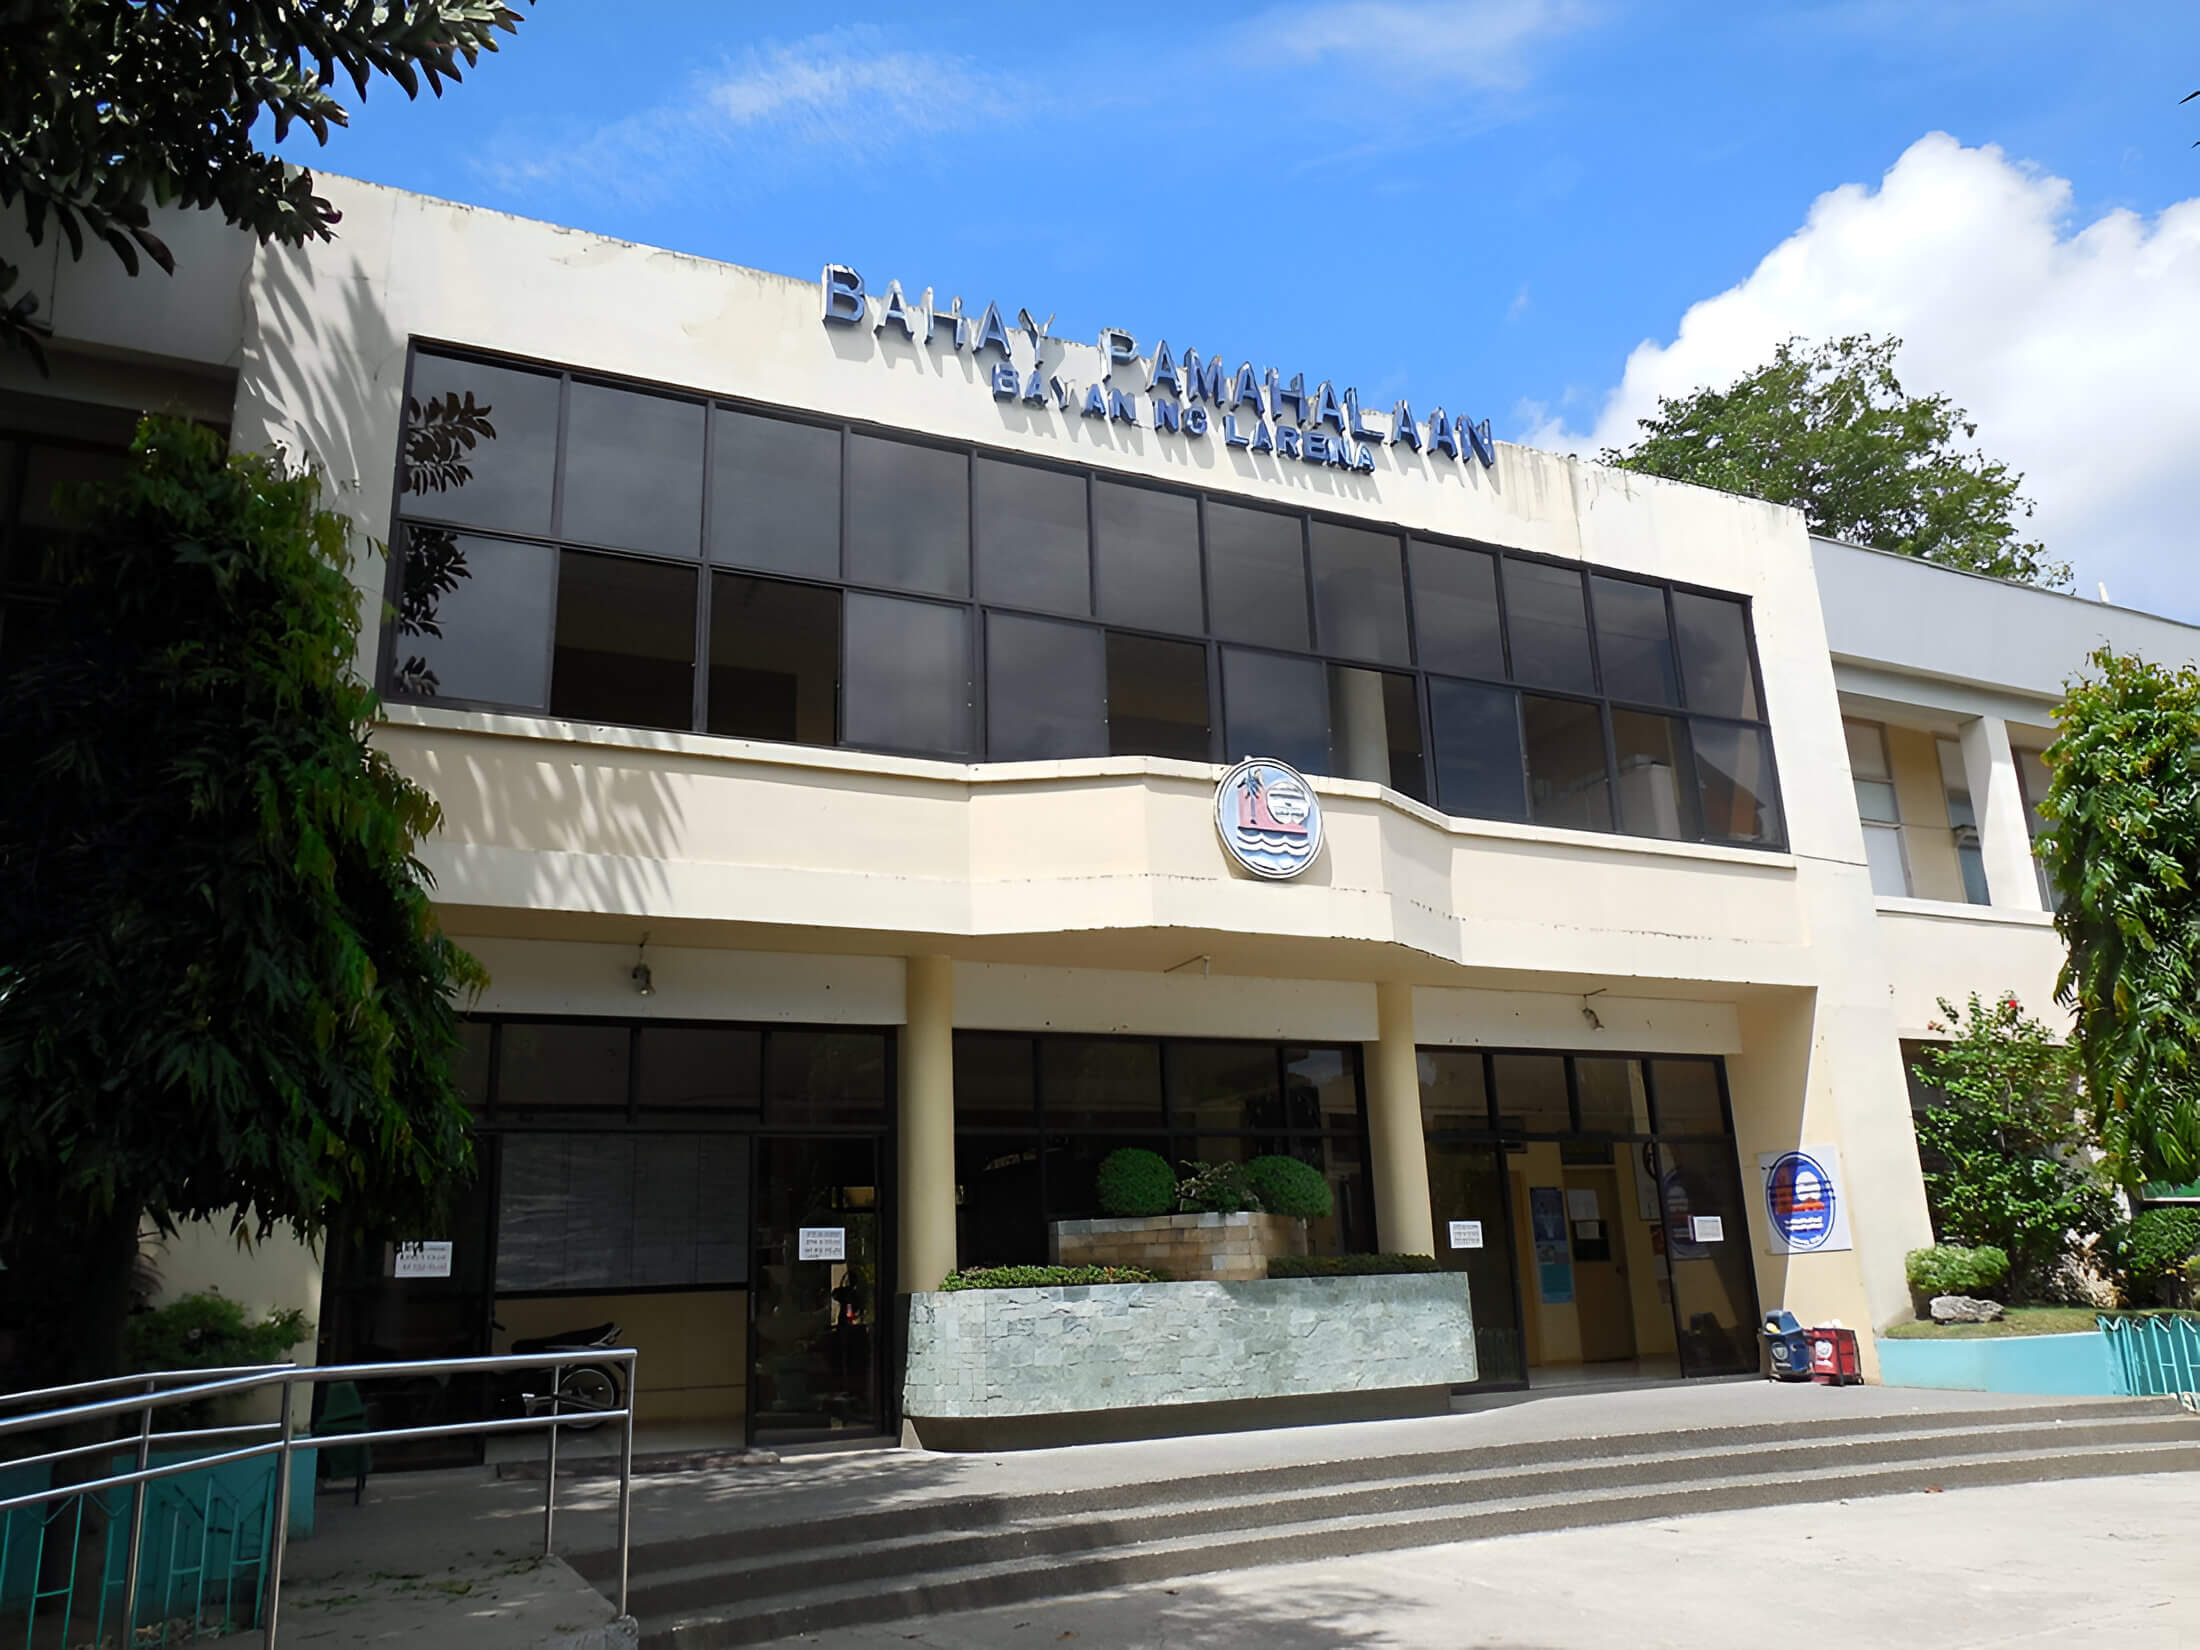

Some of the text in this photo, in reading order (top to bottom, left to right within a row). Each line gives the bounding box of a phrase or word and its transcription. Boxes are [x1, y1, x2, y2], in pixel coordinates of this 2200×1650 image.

[821, 263, 1495, 469] BAHAY PAMAHALAAN
[991, 363, 1376, 476] BAYAN NG LARENA
